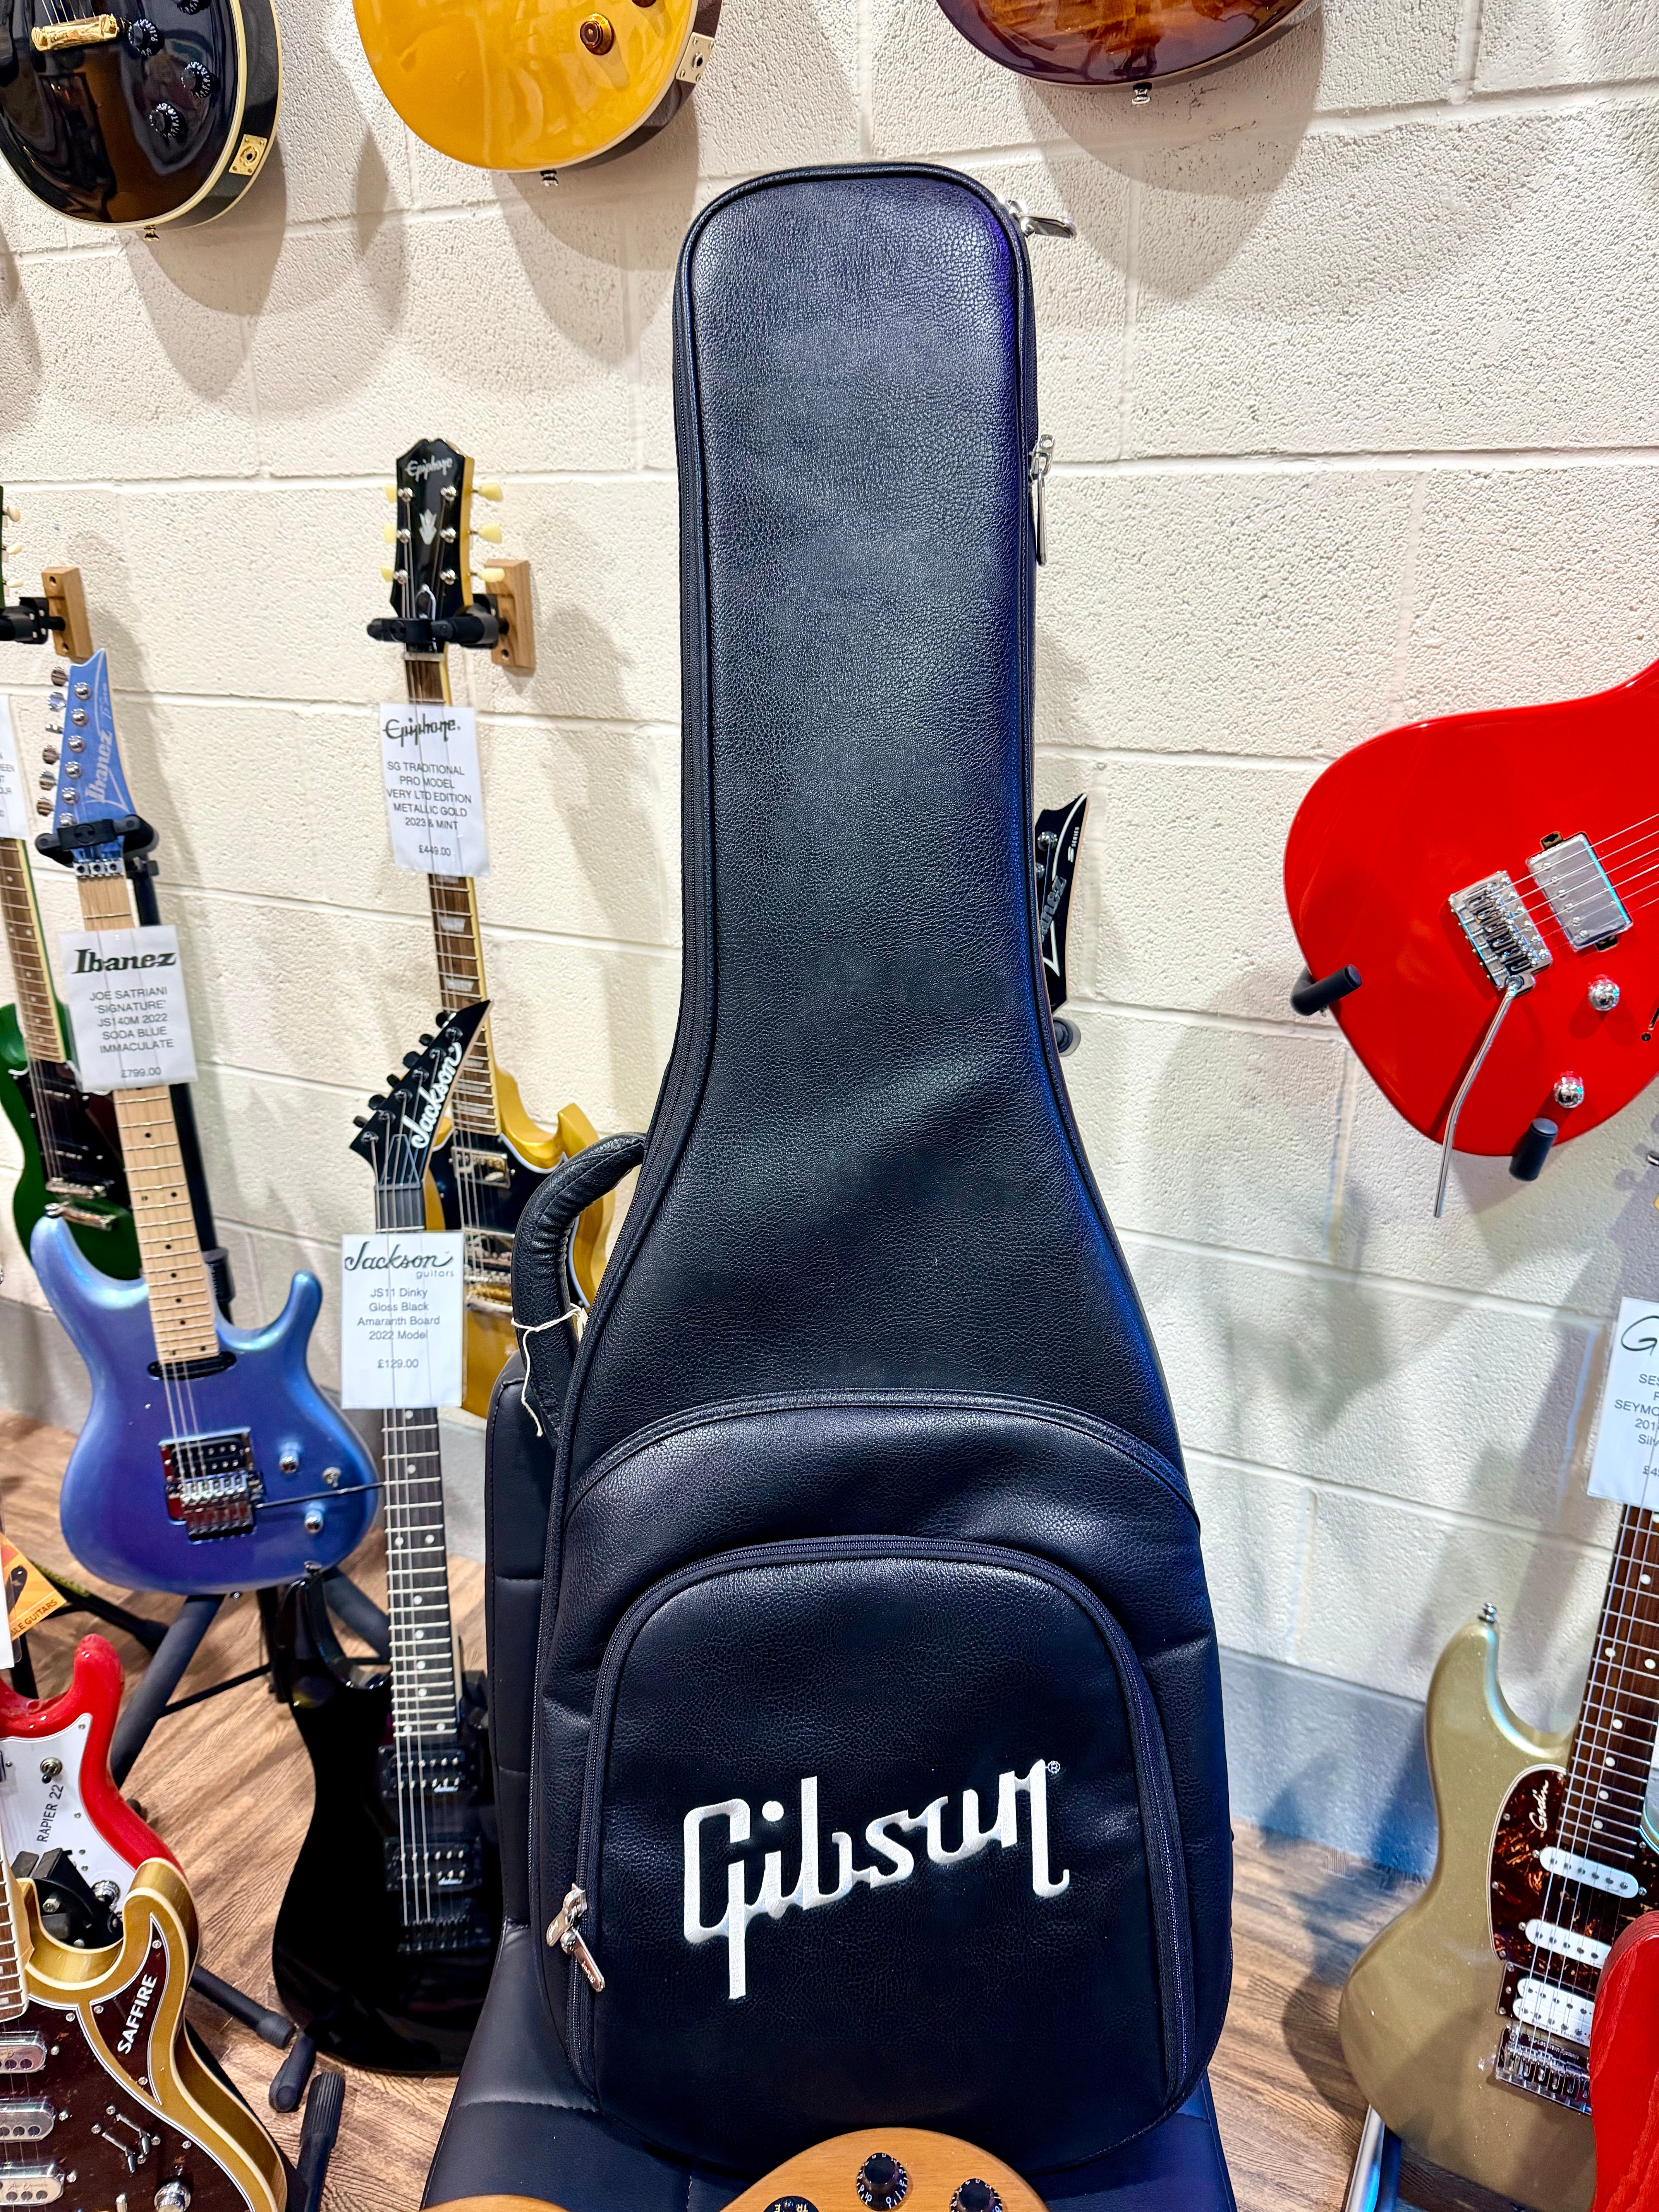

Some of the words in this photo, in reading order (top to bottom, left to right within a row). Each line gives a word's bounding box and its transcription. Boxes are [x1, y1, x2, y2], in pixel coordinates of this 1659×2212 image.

[404, 455, 453, 482] Epiphone
[382, 713, 456, 747] Epiphone
[85, 729, 113, 804] Ibanez
[387, 761, 401, 771] SG
[403, 762, 465, 775] TRADITIONAL
[400, 776, 421, 786] PRO
[423, 778, 455, 789] MODEL
[387, 788, 412, 799] VERY
[414, 790, 432, 800] LTD
[434, 792, 472, 804] EDITION
[393, 803, 438, 815] METALLIC
[441, 807, 467, 817] GOLD
[405, 817, 426, 827] 2023
[428, 819, 434, 828] &
[436, 819, 459, 830] MINT
[71, 948, 177, 974] Ibanez
[89, 990, 112, 1001] JOE
[115, 986, 168, 1000] SATRIANI
[98, 1015, 139, 1027] JS140M
[142, 1013, 168, 1024] 2022
[102, 1030, 134, 1040] SODA
[137, 1026, 167, 1036] BLUE
[100, 1038, 174, 1053] IMMACULATE
[120, 1066, 161, 1079] £799.00
[402, 1042, 462, 1149] Jackson
[344, 1240, 454, 1271] Jackson
[415, 1269, 454, 1280] guitars
[370, 1288, 395, 1297] JS11
[399, 1287, 428, 1299] Dinky
[369, 1302, 398, 1312] Gloss
[401, 1302, 429, 1311] Black
[357, 1316, 407, 1326] Amaranth
[409, 1316, 441, 1325] Board
[369, 1330, 394, 1340] 2022
[397, 1329, 428, 1340] Model
[377, 1358, 419, 1369] £129.00
[1635, 1418, 1659, 1431] 201
[24, 1599, 58, 1625] GUITARS
[1528, 1779, 1549, 1832] Godin
[36, 1803, 58, 1843] RAPIER
[49, 1784, 64, 1800] 22
[684, 1758, 1070, 2000] Gibson
[117, 1973, 158, 2055] SAFFIRE
